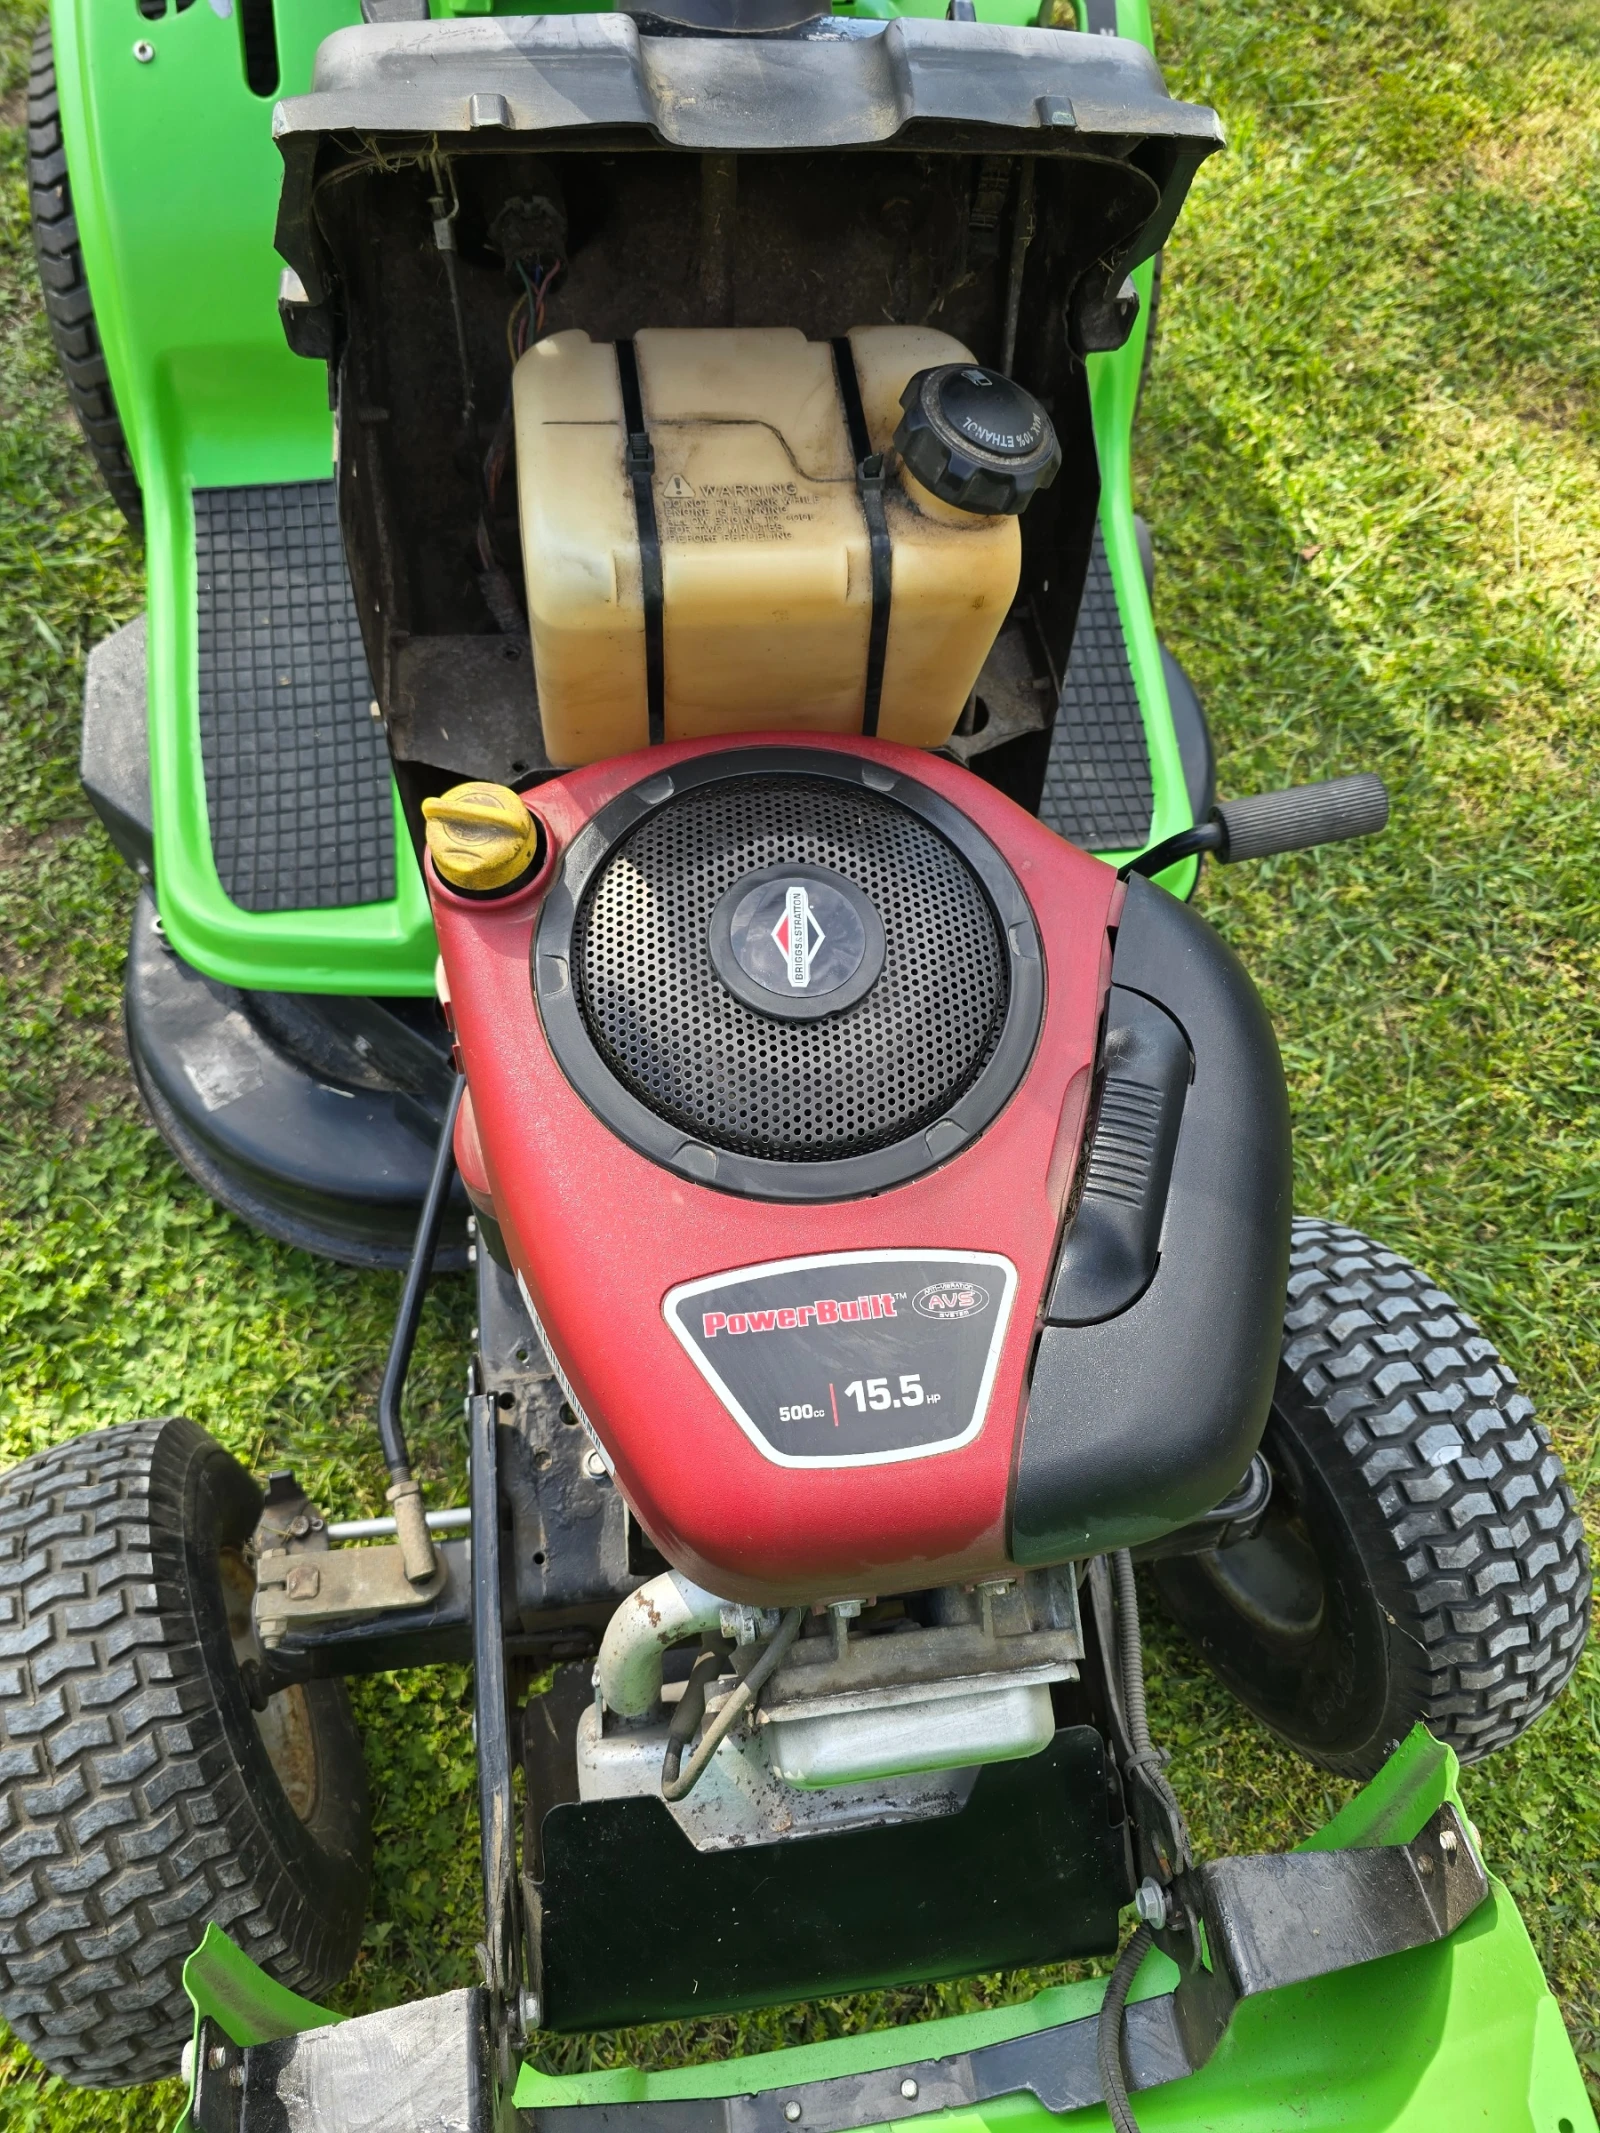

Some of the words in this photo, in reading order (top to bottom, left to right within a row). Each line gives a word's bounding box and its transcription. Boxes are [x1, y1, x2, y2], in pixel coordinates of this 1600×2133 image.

[962, 416, 1015, 448] ETHANOL
[1015, 431, 1034, 448] 10%
[699, 482, 798, 498] WARNING
[664, 500, 681, 508] DO
[686, 499, 709, 508] NOT
[715, 499, 741, 508] FILL
[746, 498, 778, 507] TANK
[782, 495, 821, 505] WHILE
[664, 508, 711, 517] ENGINE
[715, 507, 728, 516] IS
[667, 517, 709, 526] ALLOW
[715, 515, 760, 525] ENGINE
[764, 514, 779, 523] TO
[667, 525, 692, 534] FOR
[695, 525, 723, 534] TWO
[728, 523, 785, 534] MINUTES
[669, 534, 718, 543] BEFORE
[924, 1283, 974, 1295] ANTI-VIBRATION
[928, 1291, 975, 1310] AVS
[939, 1309, 970, 1318] SYSTEM
